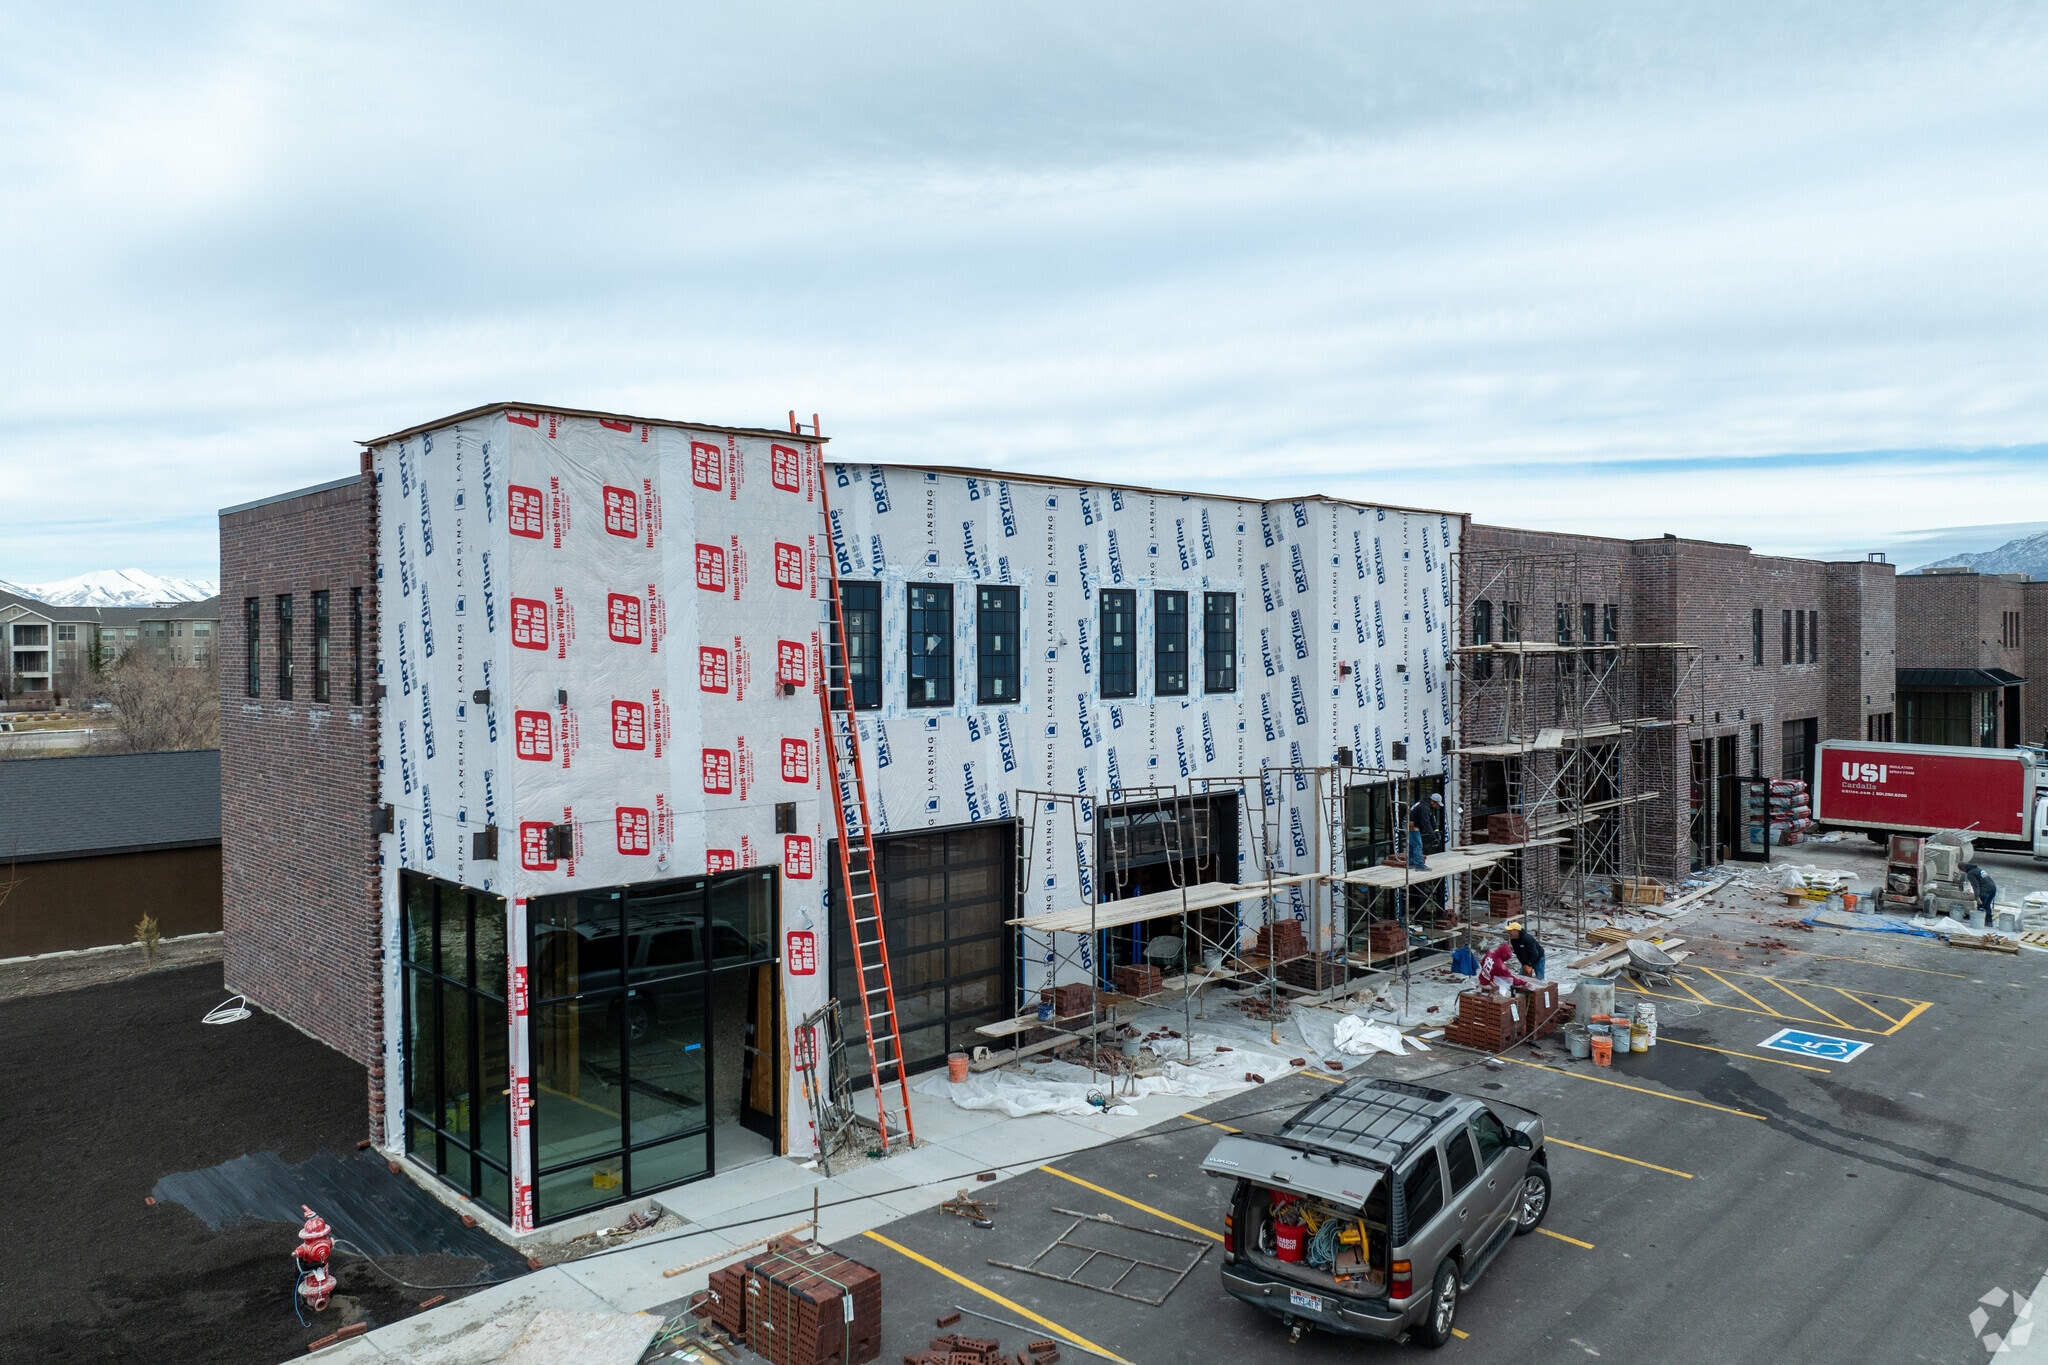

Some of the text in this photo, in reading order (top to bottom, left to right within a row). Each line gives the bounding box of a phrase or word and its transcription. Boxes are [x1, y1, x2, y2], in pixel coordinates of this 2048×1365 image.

[454, 425, 462, 482] LANSIN
[695, 447, 707, 483] Grip
[707, 451, 719, 485] Rite
[728, 434, 737, 500] House-Wrap-LWE
[775, 450, 786, 485] Grip
[786, 454, 797, 487] Rite
[421, 482, 432, 557] DRYline
[512, 492, 526, 531] Grip
[526, 495, 540, 532] Rite
[551, 476, 561, 549] House-Wrap-LWE
[607, 492, 621, 530] Grip
[621, 496, 634, 532] Rite
[643, 478, 654, 548] House-Wrap-LWE
[999, 480, 1014, 538] DRYline
[830, 509, 853, 576] DRYline
[1176, 519, 1189, 571] DRYline
[1202, 509, 1213, 560] DRYline
[399, 525, 410, 598] DRYline
[699, 549, 711, 585] Grip
[711, 553, 723, 586] Rite
[731, 535, 740, 601] House-Wrap-LWE
[778, 548, 789, 583] Grip
[789, 552, 800, 584] Rite
[808, 535, 817, 599] House-Wrap-LWE
[1108, 529, 1122, 585] DRYline
[1291, 544, 1306, 594] DRYline
[482, 552, 494, 633] DRYline
[1261, 564, 1275, 613] DRYline
[422, 584, 433, 658] DRYline
[514, 604, 530, 643] Grip
[530, 607, 546, 644] Rite
[554, 587, 566, 659] House-Wrap-LWE
[611, 599, 625, 637] Grip
[625, 603, 639, 638] Rite
[648, 584, 658, 653] House-Wrap-LWE
[1291, 610, 1306, 660] DRYline
[399, 623, 411, 696] DRYline
[702, 652, 714, 687] Grip
[714, 655, 726, 687] Rite
[733, 636, 744, 701] House-Wrap-LWE
[782, 646, 793, 680] Grip
[792, 649, 803, 681] Rite
[811, 631, 819, 694] House-Wrap-LWE
[1261, 629, 1275, 678] DRYline
[1261, 693, 1275, 742] DRYline
[1291, 675, 1306, 726] DRYline
[422, 684, 434, 760] DRYline
[519, 717, 535, 755] Grip
[535, 719, 550, 754] Rite
[615, 706, 629, 743] Grip
[629, 709, 643, 744] Rite
[652, 688, 662, 758] House-Wrap-LWE
[1078, 693, 1093, 748] DRYline
[1202, 712, 1215, 763] DRYline
[400, 722, 411, 795] DRYline
[784, 743, 795, 777] Grip
[795, 746, 806, 777] Rite
[998, 713, 1014, 772] DRYline
[1176, 726, 1189, 778] DRYline
[705, 754, 717, 789] Grip
[717, 756, 730, 788] Rite
[737, 736, 747, 801] House-Wrap-LWE
[1842, 762, 1887, 784] USI
[1842, 782, 1877, 790] Cardalls
[963, 762, 981, 823] DRYline
[422, 785, 434, 861] DRYline
[619, 813, 634, 850] Grip
[634, 815, 647, 849] Rite
[1291, 806, 1306, 857] DRYline
[524, 828, 540, 865] Grip
[788, 840, 799, 874] Grip
[799, 842, 810, 873] Rite
[791, 937, 802, 970] Grip
[802, 938, 813, 969] Rite
[517, 1083, 530, 1120] Grip
